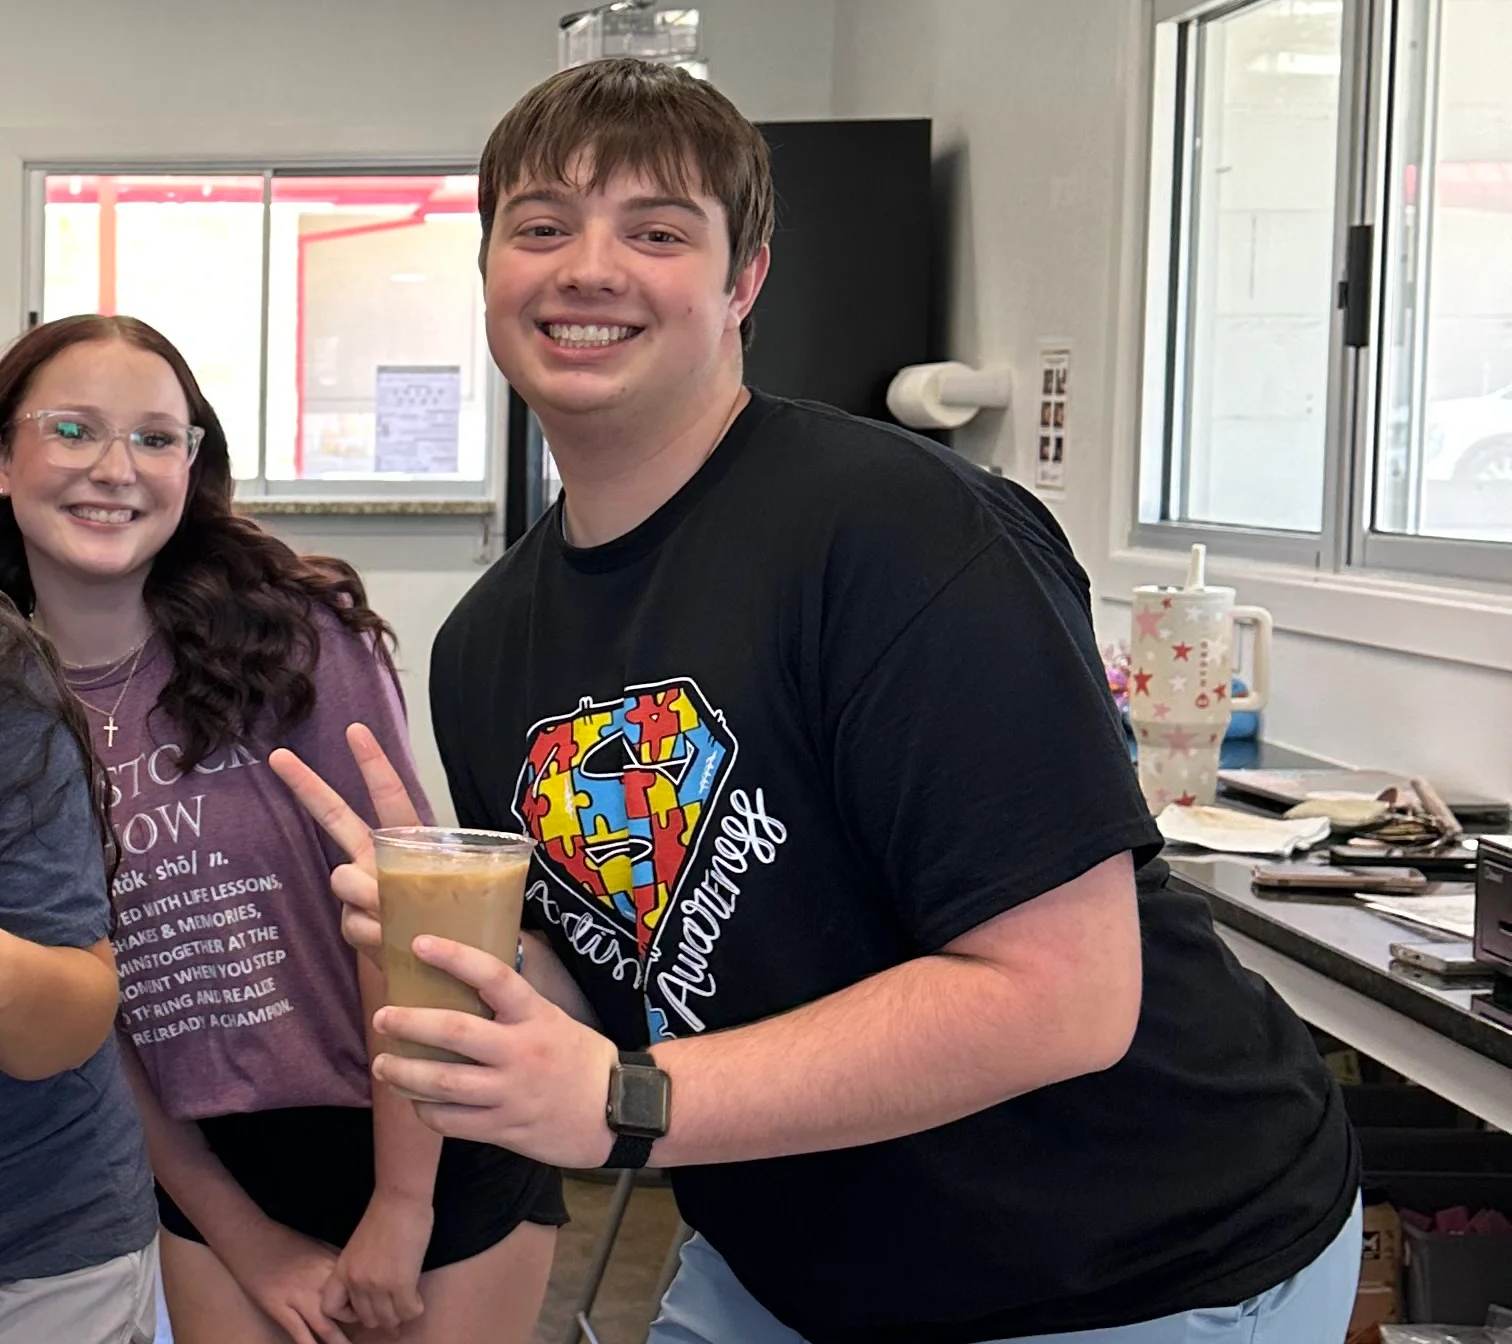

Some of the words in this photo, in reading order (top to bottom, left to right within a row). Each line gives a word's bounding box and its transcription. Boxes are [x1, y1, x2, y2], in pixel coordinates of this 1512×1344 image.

[183, 887, 210, 906] LIFE
[210, 873, 283, 901] LESSONS,
[160, 923, 177, 939] &
[177, 903, 262, 933] MEMORIES,
[151, 939, 225, 968] TOGETHER
[228, 932, 247, 952] AT
[247, 926, 279, 944] THE
[173, 964, 217, 984] WHEN
[217, 958, 253, 978] YOU
[252, 949, 286, 970] STEP
[153, 993, 194, 1017] RING
[197, 989, 222, 1005] AND
[210, 1014, 220, 1028] A
